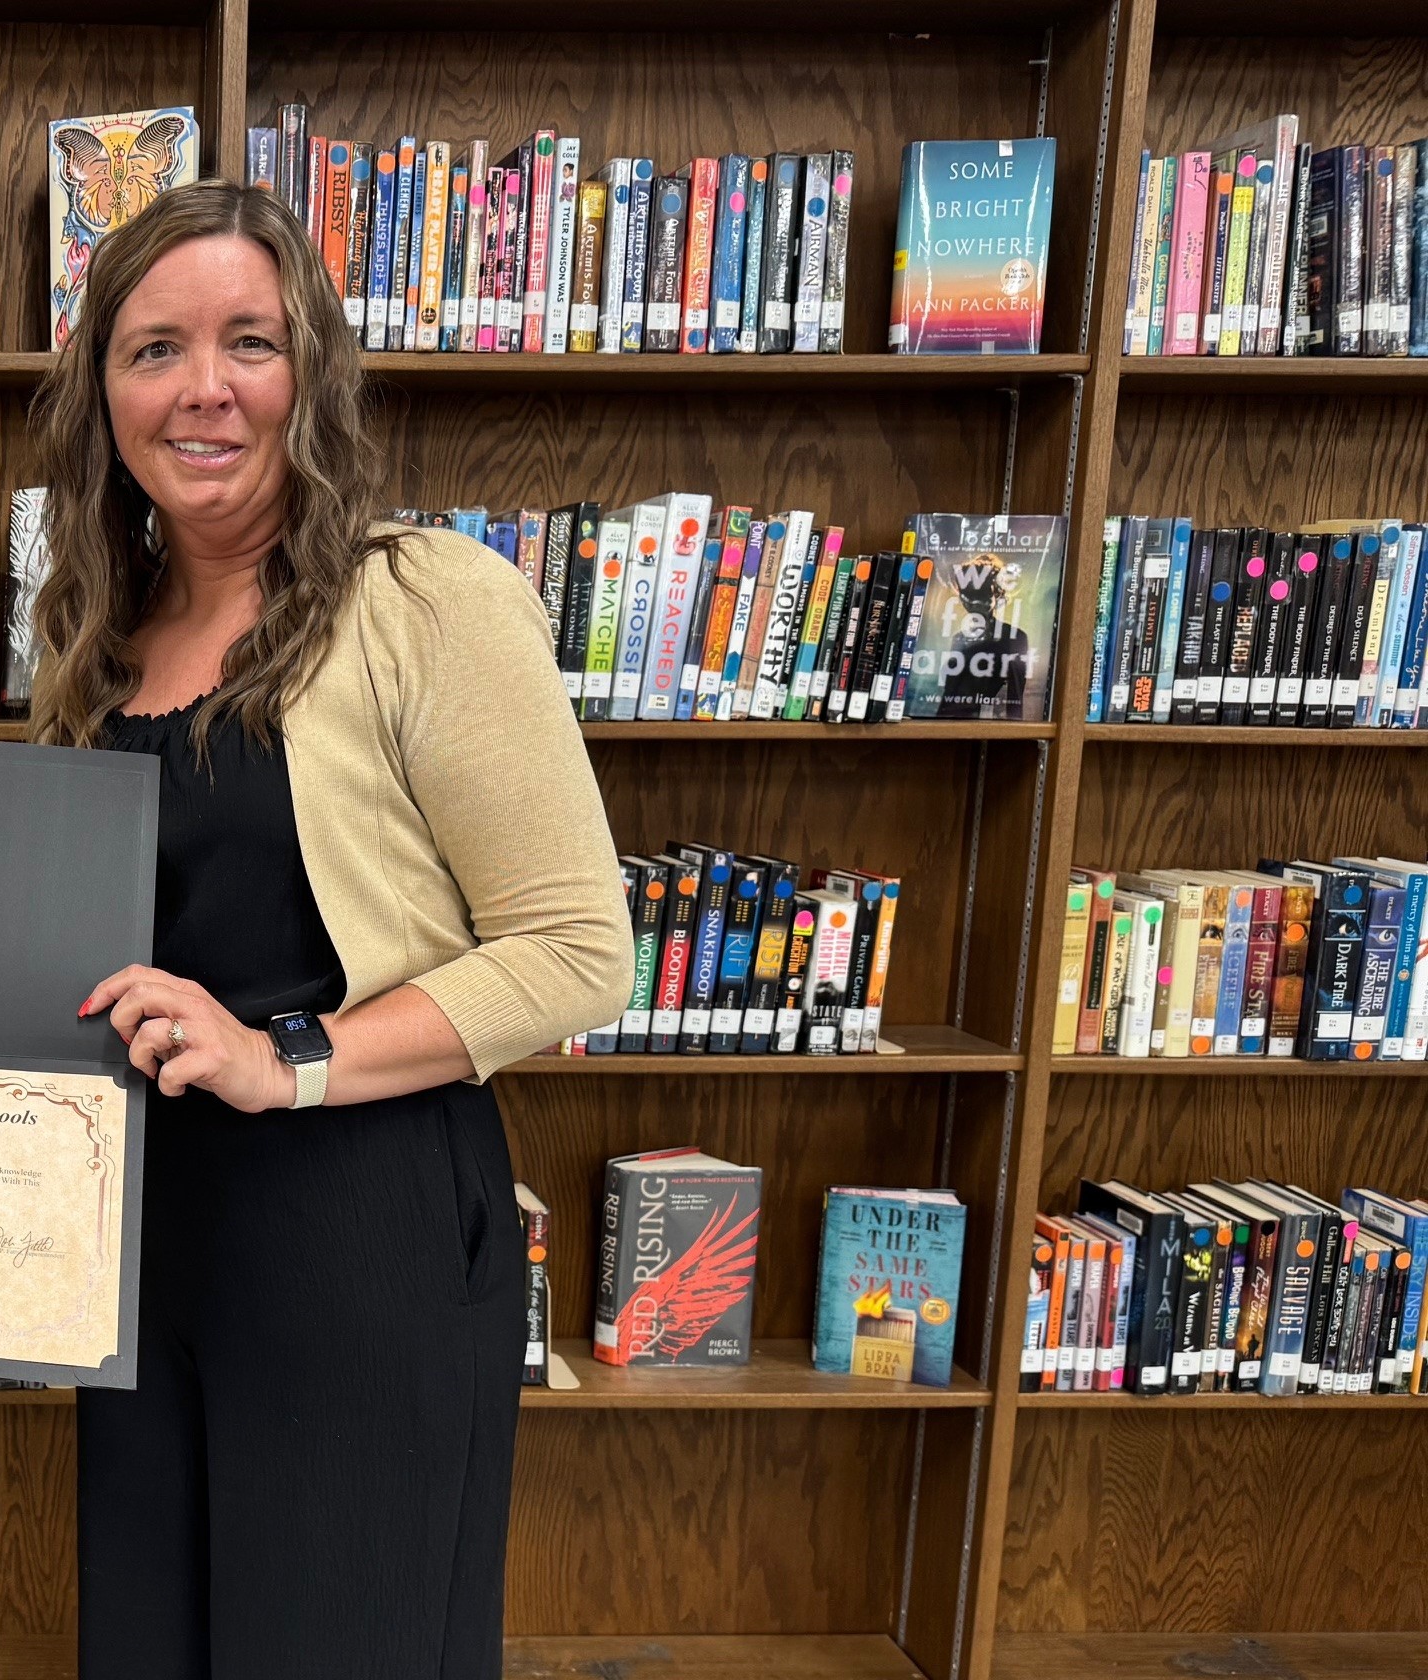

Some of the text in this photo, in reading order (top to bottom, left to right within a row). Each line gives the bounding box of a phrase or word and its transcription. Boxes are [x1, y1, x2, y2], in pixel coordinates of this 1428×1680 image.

[950, 162, 1014, 180] SOME
[1148, 166, 1156, 193] ROALD
[330, 170, 346, 237] RIBSY
[399, 172, 412, 219] CLEMENTS
[936, 199, 1024, 218] BRIGHT
[556, 207, 571, 303] TYLER JOHNSON WAS
[804, 219, 823, 287] AIRMAN
[917, 237, 1035, 256] NOWHERE
[912, 297, 1029, 313] ANN PACKER
[750, 521, 766, 548] POINT
[953, 563, 1022, 590] we
[566, 581, 580, 649] ALLY CONDIE
[594, 579, 618, 671] MATCHE
[655, 570, 687, 690] REACHED
[735, 593, 751, 632] FAKE
[759, 564, 802, 685] WORTHY
[808, 579, 829, 642] CODE ORANGE
[941, 596, 1022, 639] fell
[1118, 538, 1144, 686] The Butterfly Girl Rene Denfeld
[1289, 606, 1307, 676] THE BODY FINDER
[912, 648, 1040, 686] apart
[695, 909, 721, 1000] SNAKEROOT
[725, 933, 749, 984] RIFT
[817, 928, 835, 980] CRICHTON
[832, 931, 851, 977] MICHAEL
[1335, 943, 1352, 978] DARK
[1331, 980, 1348, 1007] FIRE
[1, 1176, 20, 1185] With
[23, 1178, 40, 1187] This
[851, 1204, 940, 1233] UNDER
[601, 1193, 619, 1295] RED RISING
[867, 1229, 920, 1254] THE
[629, 1177, 671, 1357] RED RISING
[855, 1251, 928, 1277] SAME
[847, 1275, 933, 1300] STARS
[1277, 1266, 1310, 1335] SALVAGE
[1311, 1226, 1338, 1361] Gallows Hill LOIS DUNCAN
[708, 1348, 740, 1356] BROWN
[709, 1340, 738, 1348] PIERCE
[863, 1349, 901, 1364] LIBBA
[865, 1362, 897, 1376] BRAY
